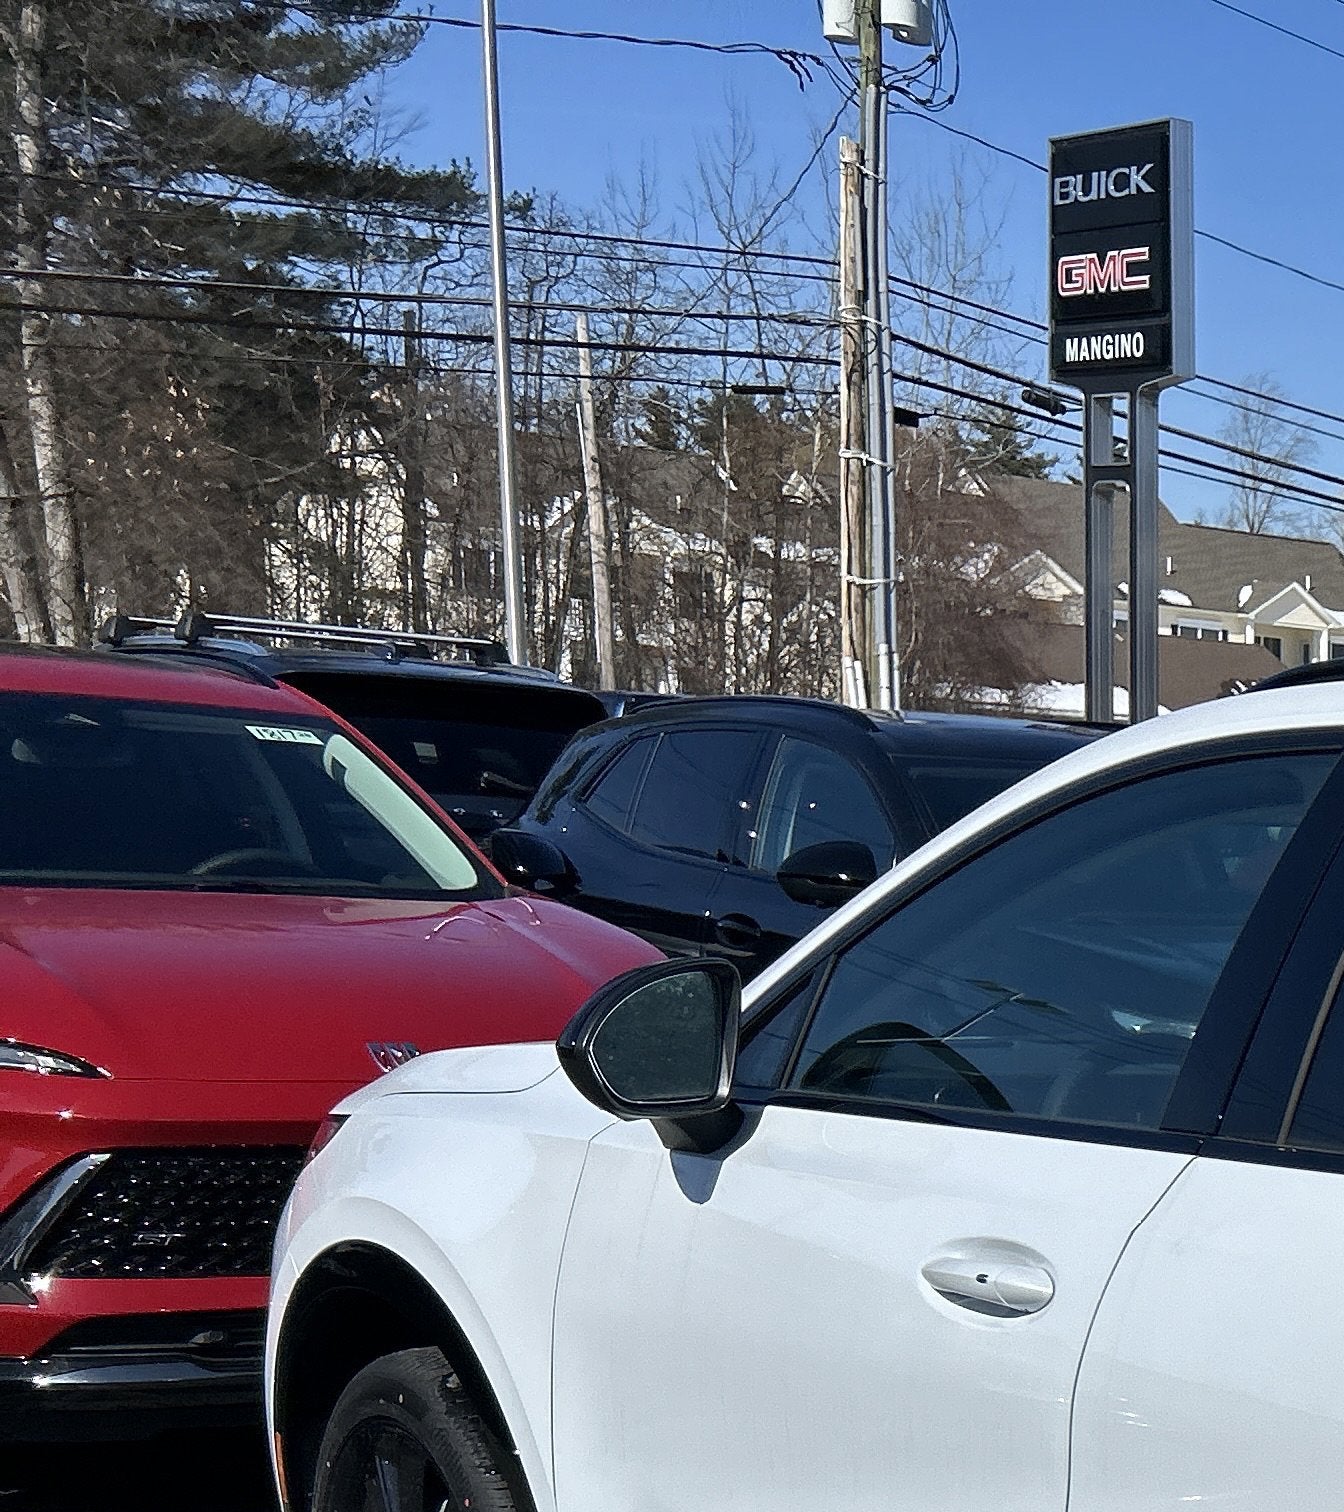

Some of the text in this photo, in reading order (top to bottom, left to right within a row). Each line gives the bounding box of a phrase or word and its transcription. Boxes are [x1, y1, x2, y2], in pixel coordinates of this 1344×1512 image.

[1054, 163, 1155, 206] BUICK
[1057, 246, 1151, 297] GMC
[1065, 332, 1144, 362] MANGINO
